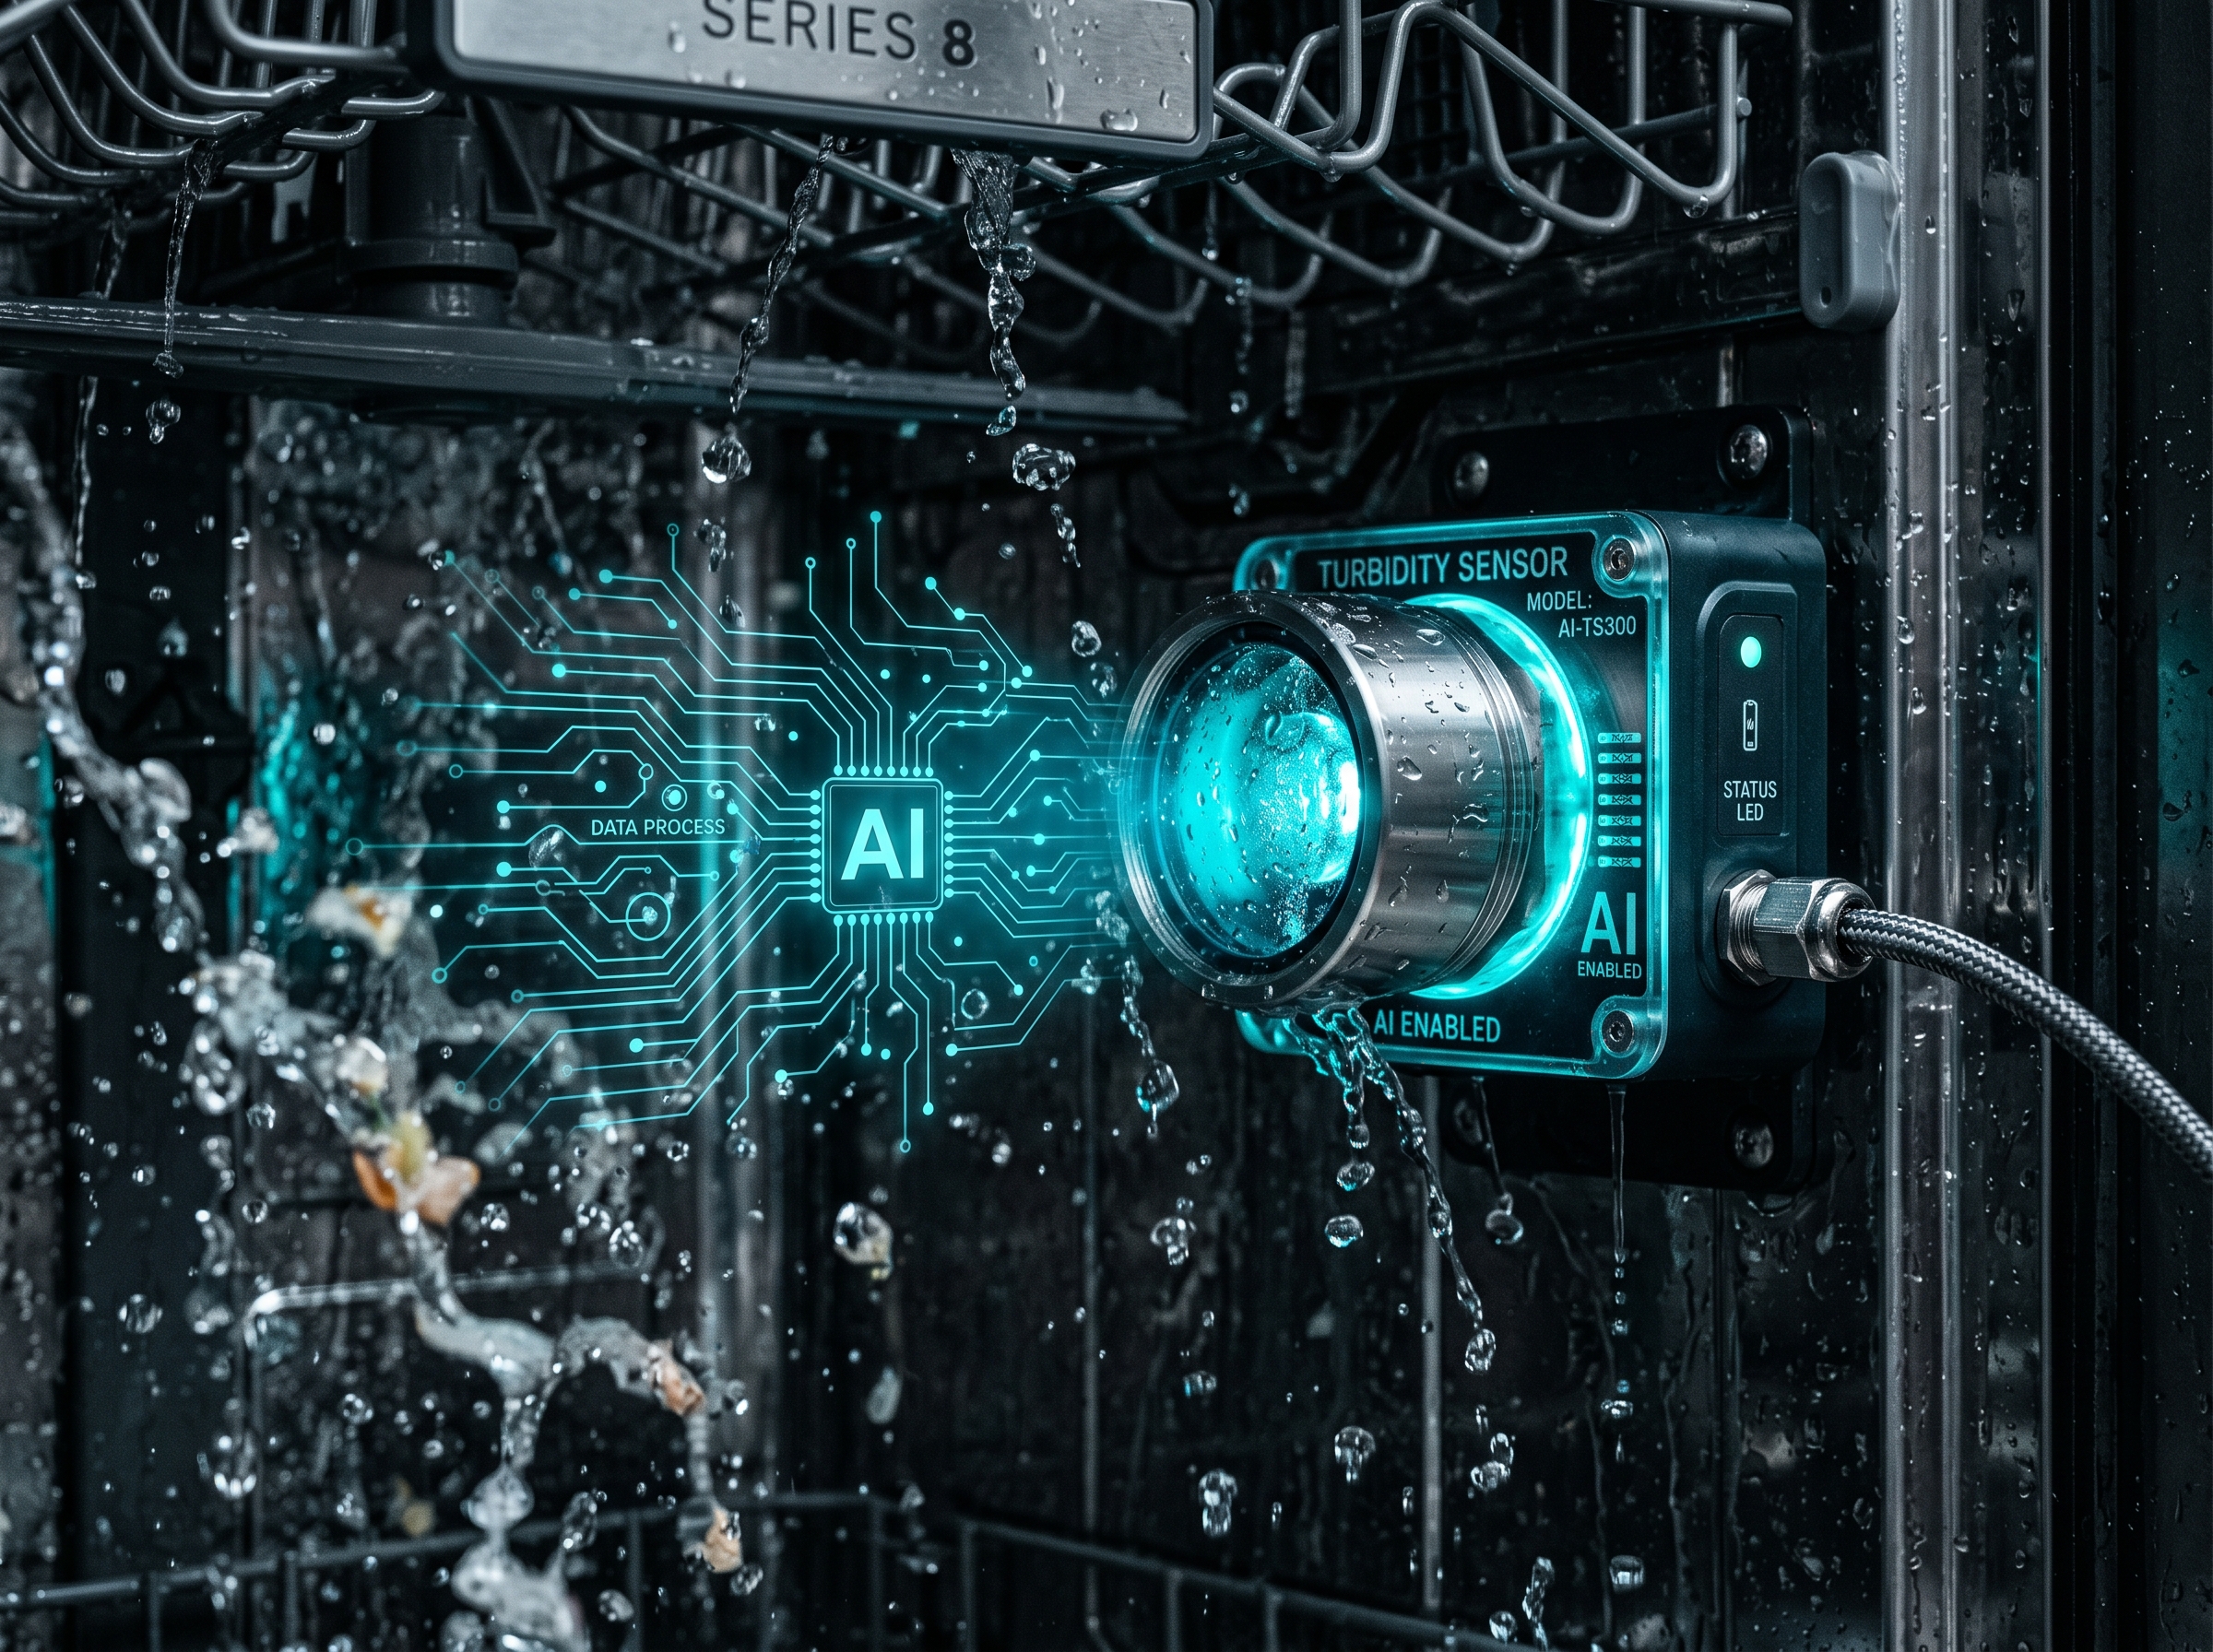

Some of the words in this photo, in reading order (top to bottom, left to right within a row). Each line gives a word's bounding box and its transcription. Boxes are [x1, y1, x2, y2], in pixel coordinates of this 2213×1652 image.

[702, 0, 916, 60] SERIES
[941, 18, 976, 67] 8
[1318, 552, 1450, 589] TURBIDITY
[1458, 547, 1568, 583] SENSOR
[1526, 591, 1592, 612] MODEL:
[1558, 616, 1637, 638] AI-TS300
[1723, 781, 1777, 798] STATUS
[1737, 803, 1764, 820] LED
[1580, 891, 1637, 956] AI
[1578, 961, 1642, 980] ENABLED
[1373, 1009, 1394, 1034] AI
[1401, 1010, 1501, 1044] ENABLED
